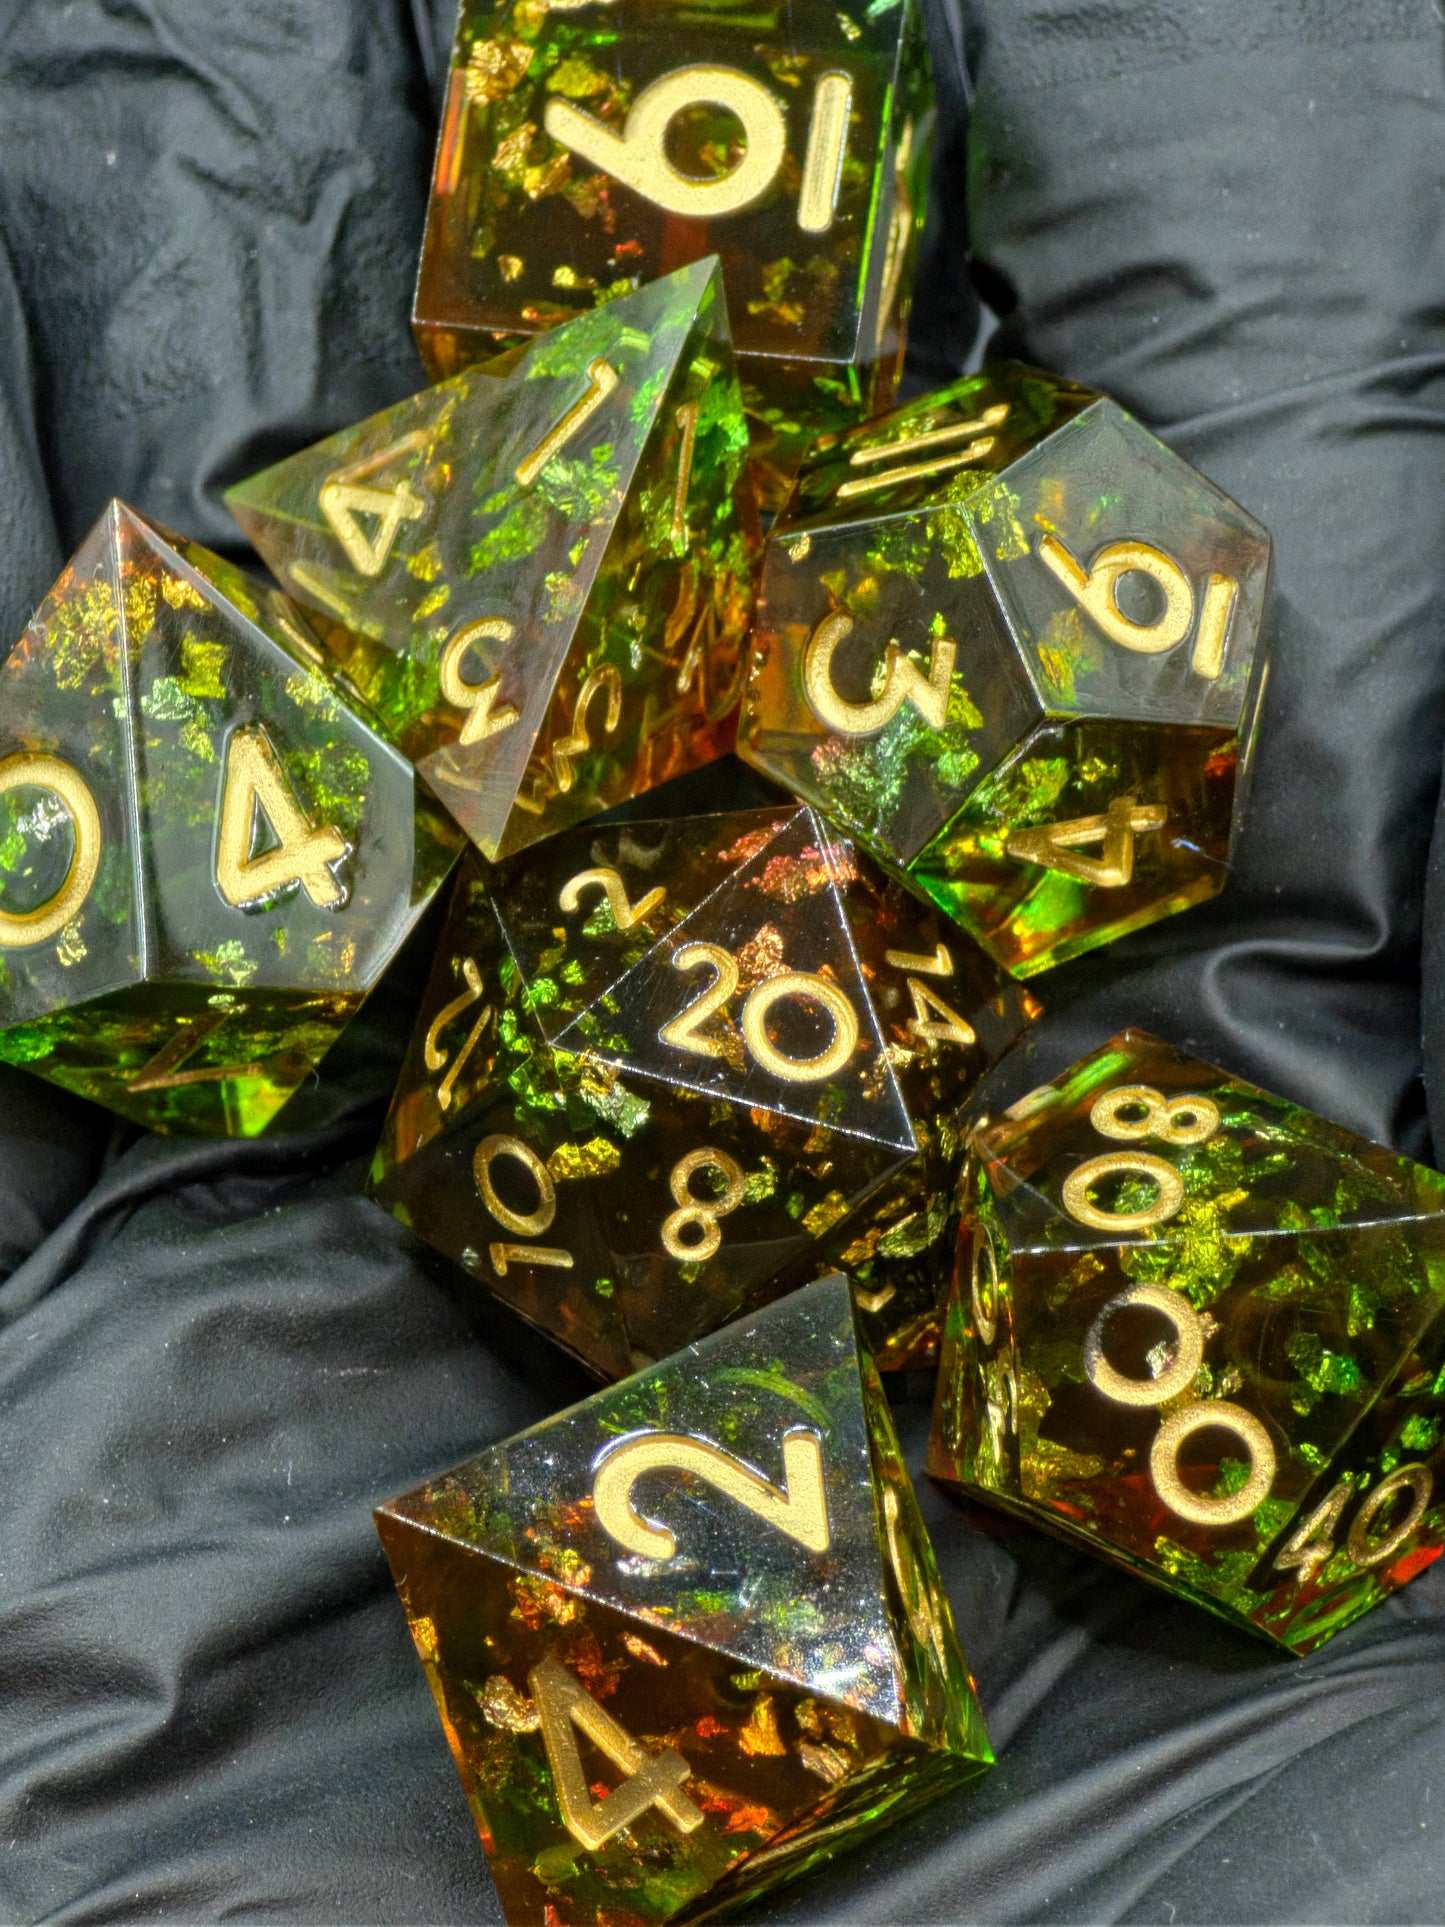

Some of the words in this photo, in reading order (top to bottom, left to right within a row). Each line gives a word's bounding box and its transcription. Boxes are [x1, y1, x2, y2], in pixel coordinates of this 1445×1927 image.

[516, 357, 620, 486] 1
[319, 479, 426, 577] 4
[439, 615, 520, 747] 3
[804, 607, 958, 737] 3
[214, 724, 352, 909] 4
[1005, 795, 1168, 888] 4
[559, 867, 667, 931] 2
[658, 941, 859, 1082] 20
[884, 942, 977, 1045] 14
[472, 1132, 574, 1277] 10
[660, 1146, 747, 1262] 8
[1084, 1281, 1277, 1526] 00
[592, 1430, 832, 1562] 2
[1272, 1460, 1435, 1583] 40
[528, 1655, 705, 1851] 4
